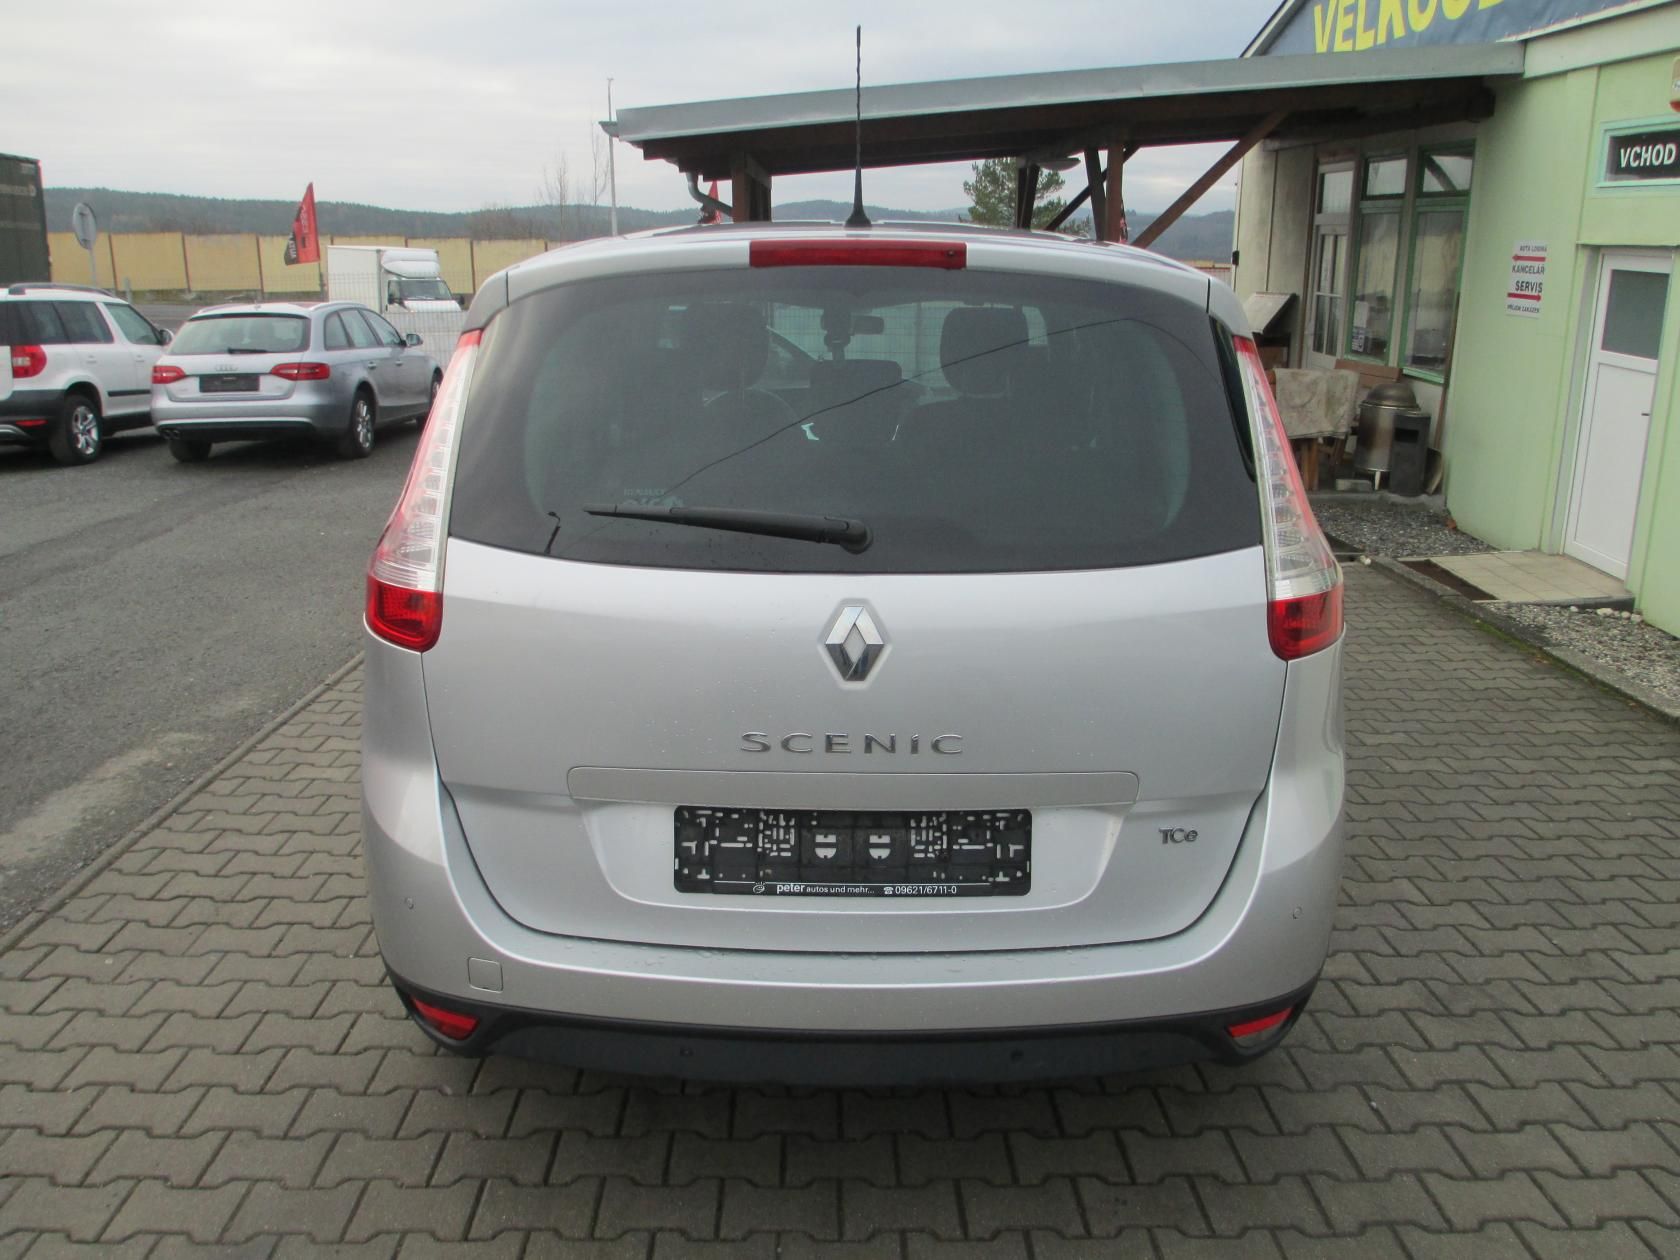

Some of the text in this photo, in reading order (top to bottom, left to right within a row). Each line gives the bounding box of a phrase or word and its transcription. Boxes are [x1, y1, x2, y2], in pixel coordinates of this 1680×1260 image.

[1620, 143, 1676, 168] VCHOD
[1515, 280, 1543, 293] SERVIS
[1159, 827, 1198, 844] TCe
[776, 883, 806, 894] peter
[806, 886, 828, 894] autos
[847, 886, 875, 894] mehr...
[895, 886, 957, 895] 09621/6711-0
